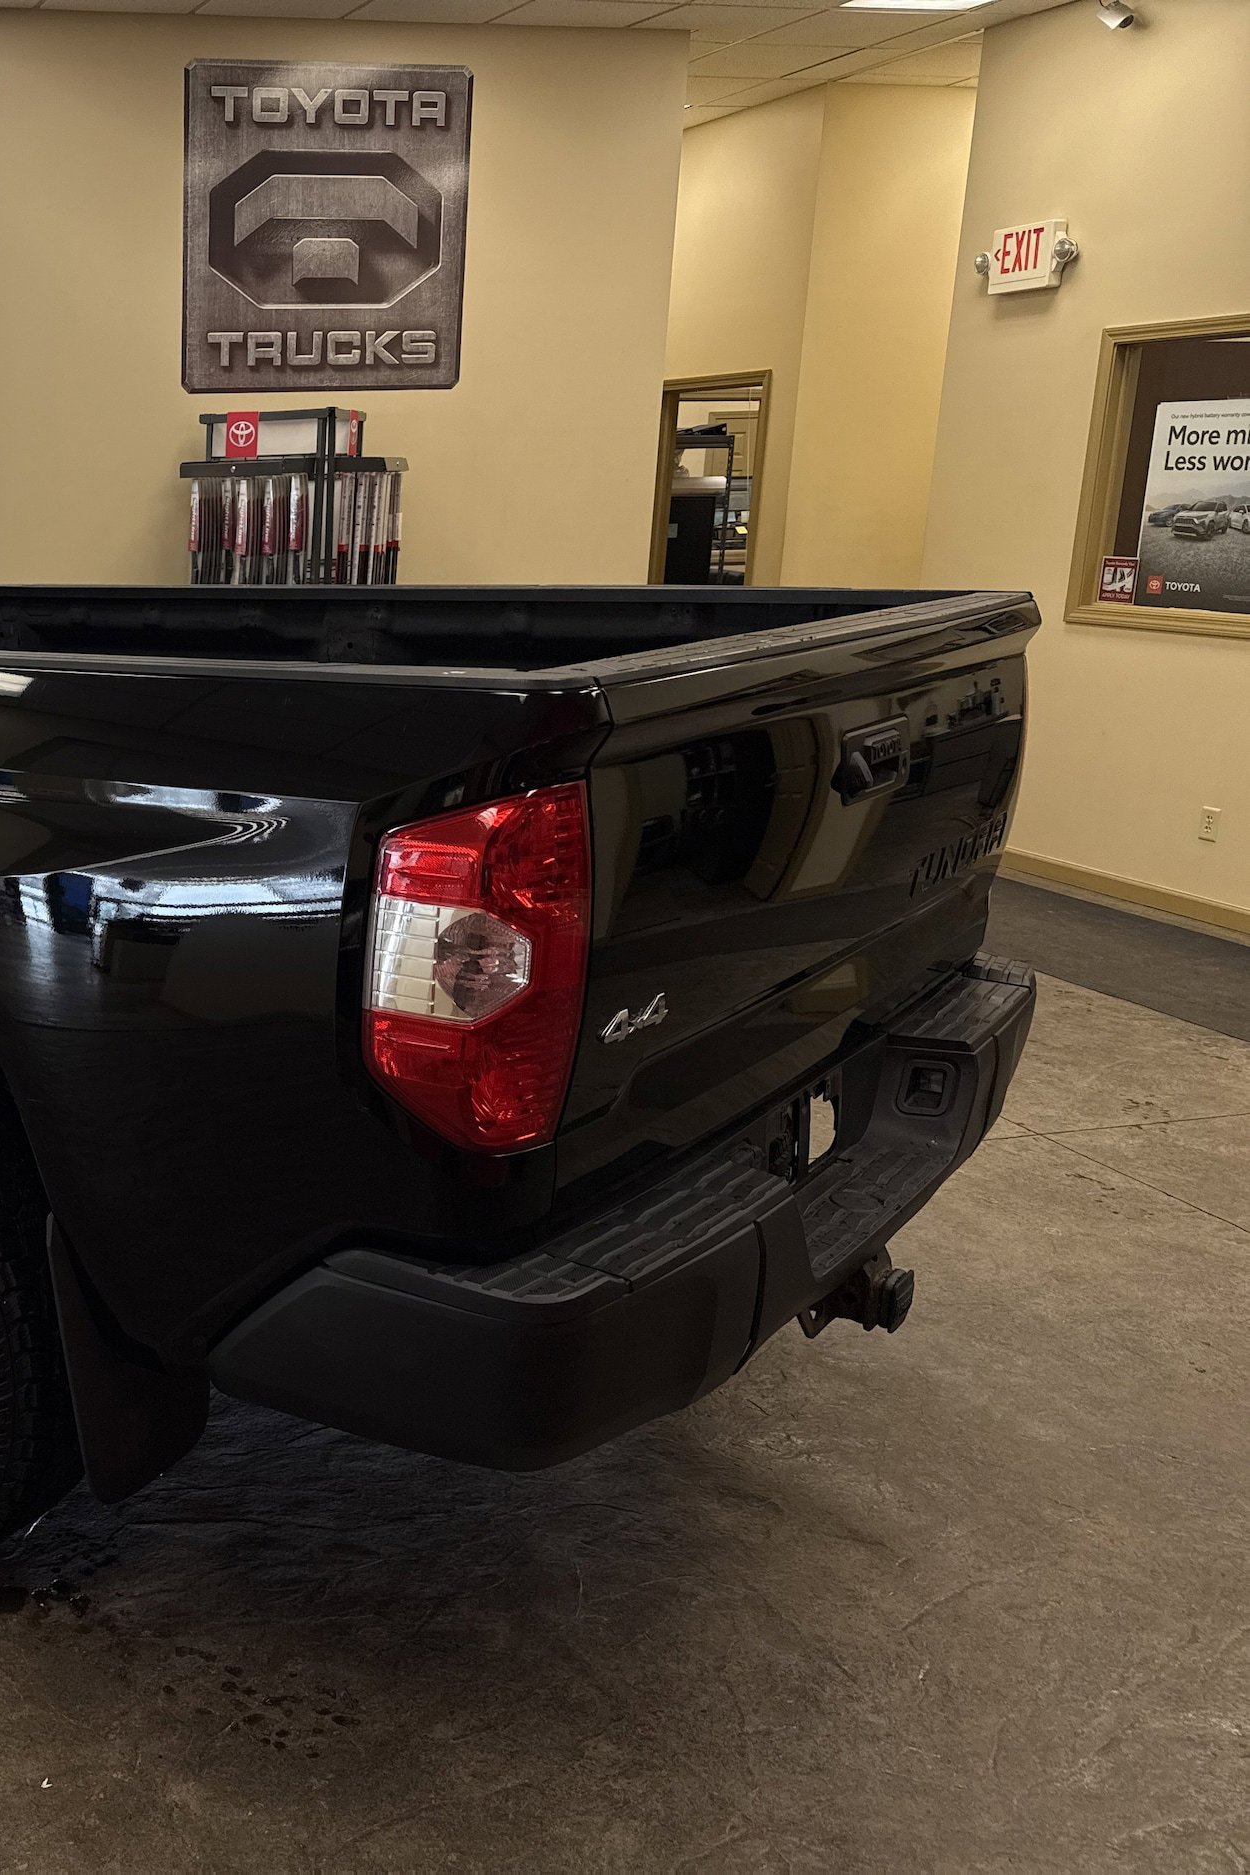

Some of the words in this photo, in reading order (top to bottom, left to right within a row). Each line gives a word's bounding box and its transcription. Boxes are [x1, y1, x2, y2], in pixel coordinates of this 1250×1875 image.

[211, 85, 447, 126] TOYOTA
[1000, 226, 1045, 275] EXIT
[207, 330, 438, 367] TRUCKS
[1168, 425, 1221, 446] More
[1164, 450, 1207, 471] Less
[1165, 581, 1201, 593] TOYOTA
[908, 810, 1008, 899] TUNDRA
